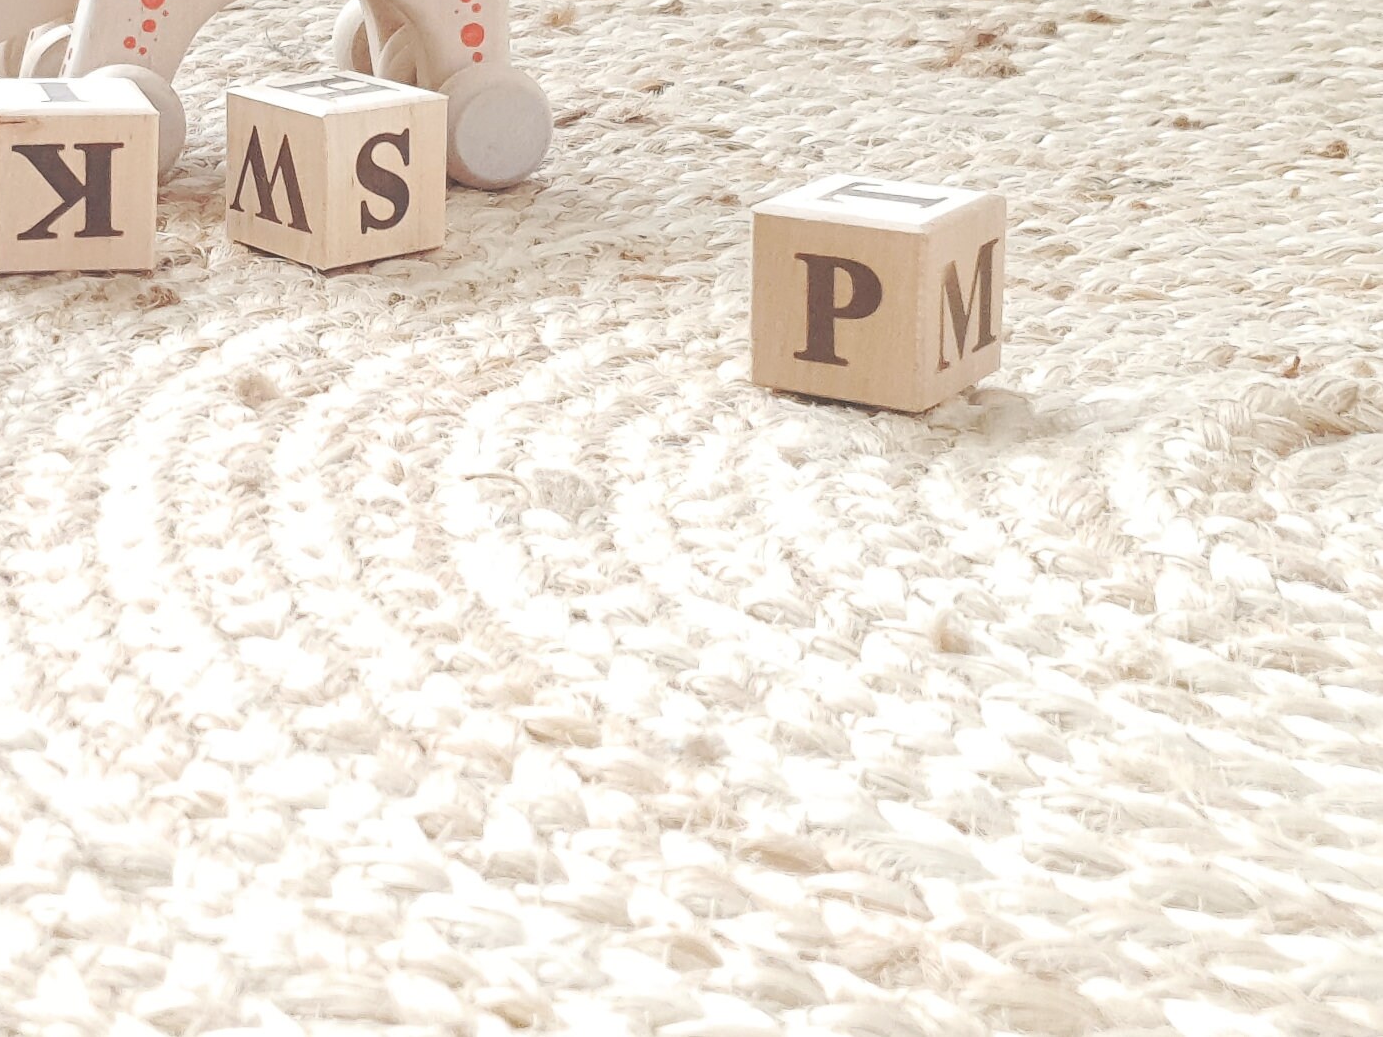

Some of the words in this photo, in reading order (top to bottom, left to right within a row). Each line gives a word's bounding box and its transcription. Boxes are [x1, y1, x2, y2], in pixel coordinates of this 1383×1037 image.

[11, 141, 125, 240] K
[356, 128, 410, 234] S
[794, 252, 883, 367] P
[937, 238, 999, 373] M
